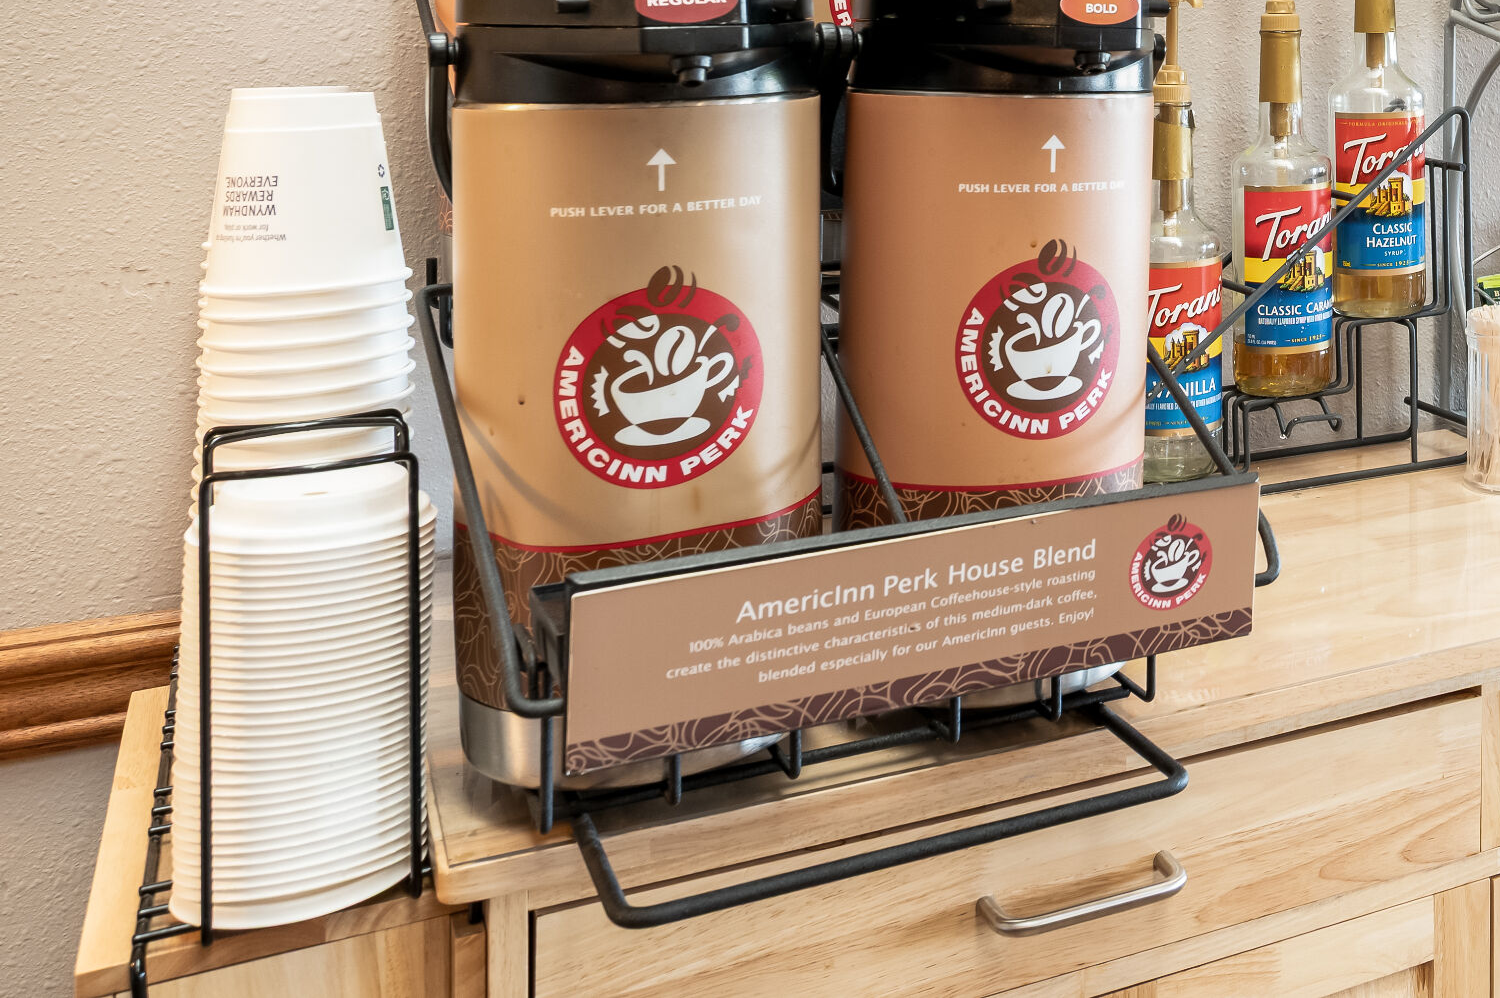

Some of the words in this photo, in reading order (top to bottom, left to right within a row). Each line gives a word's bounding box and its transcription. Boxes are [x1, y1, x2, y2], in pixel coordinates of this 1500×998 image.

[1085, 3, 1118, 14] BOLD
[225, 176, 278, 188] EVERYONE
[958, 183, 990, 193] PUSH
[993, 184, 1030, 193] LEVER
[1034, 183, 1058, 193] FOR
[1060, 182, 1069, 192] A
[1072, 181, 1108, 192] BETTER
[225, 190, 274, 202] REWARDS
[550, 207, 585, 218] PUSH
[590, 205, 634, 217] LEVER
[639, 204, 668, 214] FOR
[672, 203, 682, 212] A
[686, 198, 735, 212] BETTER
[739, 196, 762, 207] DAY
[223, 204, 277, 216] WYNDHAM
[1372, 222, 1413, 235] CLASSIC
[1366, 234, 1418, 248] HAZELNUT
[1148, 275, 1222, 336] Torani
[1257, 304, 1302, 316] CLASSIC
[960, 306, 1050, 435] AMERICINN
[1058, 367, 1113, 430] PERK
[558, 345, 668, 483] AMERICINN
[679, 404, 754, 476] PERK
[735, 582, 875, 624] AmericInn
[884, 568, 938, 597] Perk
[948, 556, 1024, 585] House
[1033, 538, 1096, 570] Blend
[1131, 551, 1172, 609] AMERICINN
[1175, 573, 1207, 605] PERK
[688, 636, 724, 654] 100%
[728, 626, 783, 647] Arabica
[787, 618, 829, 636] beans
[833, 610, 860, 627] and
[864, 601, 926, 622] European
[930, 578, 1043, 610] Coffeehouse-style
[1046, 569, 1096, 587] roasting
[666, 661, 712, 680] create
[716, 656, 741, 670] the
[745, 642, 820, 665] distinctive
[824, 623, 921, 649] characteristics
[926, 617, 940, 630] of
[944, 612, 968, 626] this
[972, 596, 1053, 621] medium-dark
[1057, 589, 1097, 605] coffee,
[758, 661, 816, 683] blended
[820, 649, 888, 673] especially
[892, 644, 910, 658] for
[916, 639, 938, 652] our
[942, 626, 1006, 647] AmericInn
[1010, 618, 1054, 636] guests.
[1058, 607, 1094, 624] Enjoy!
